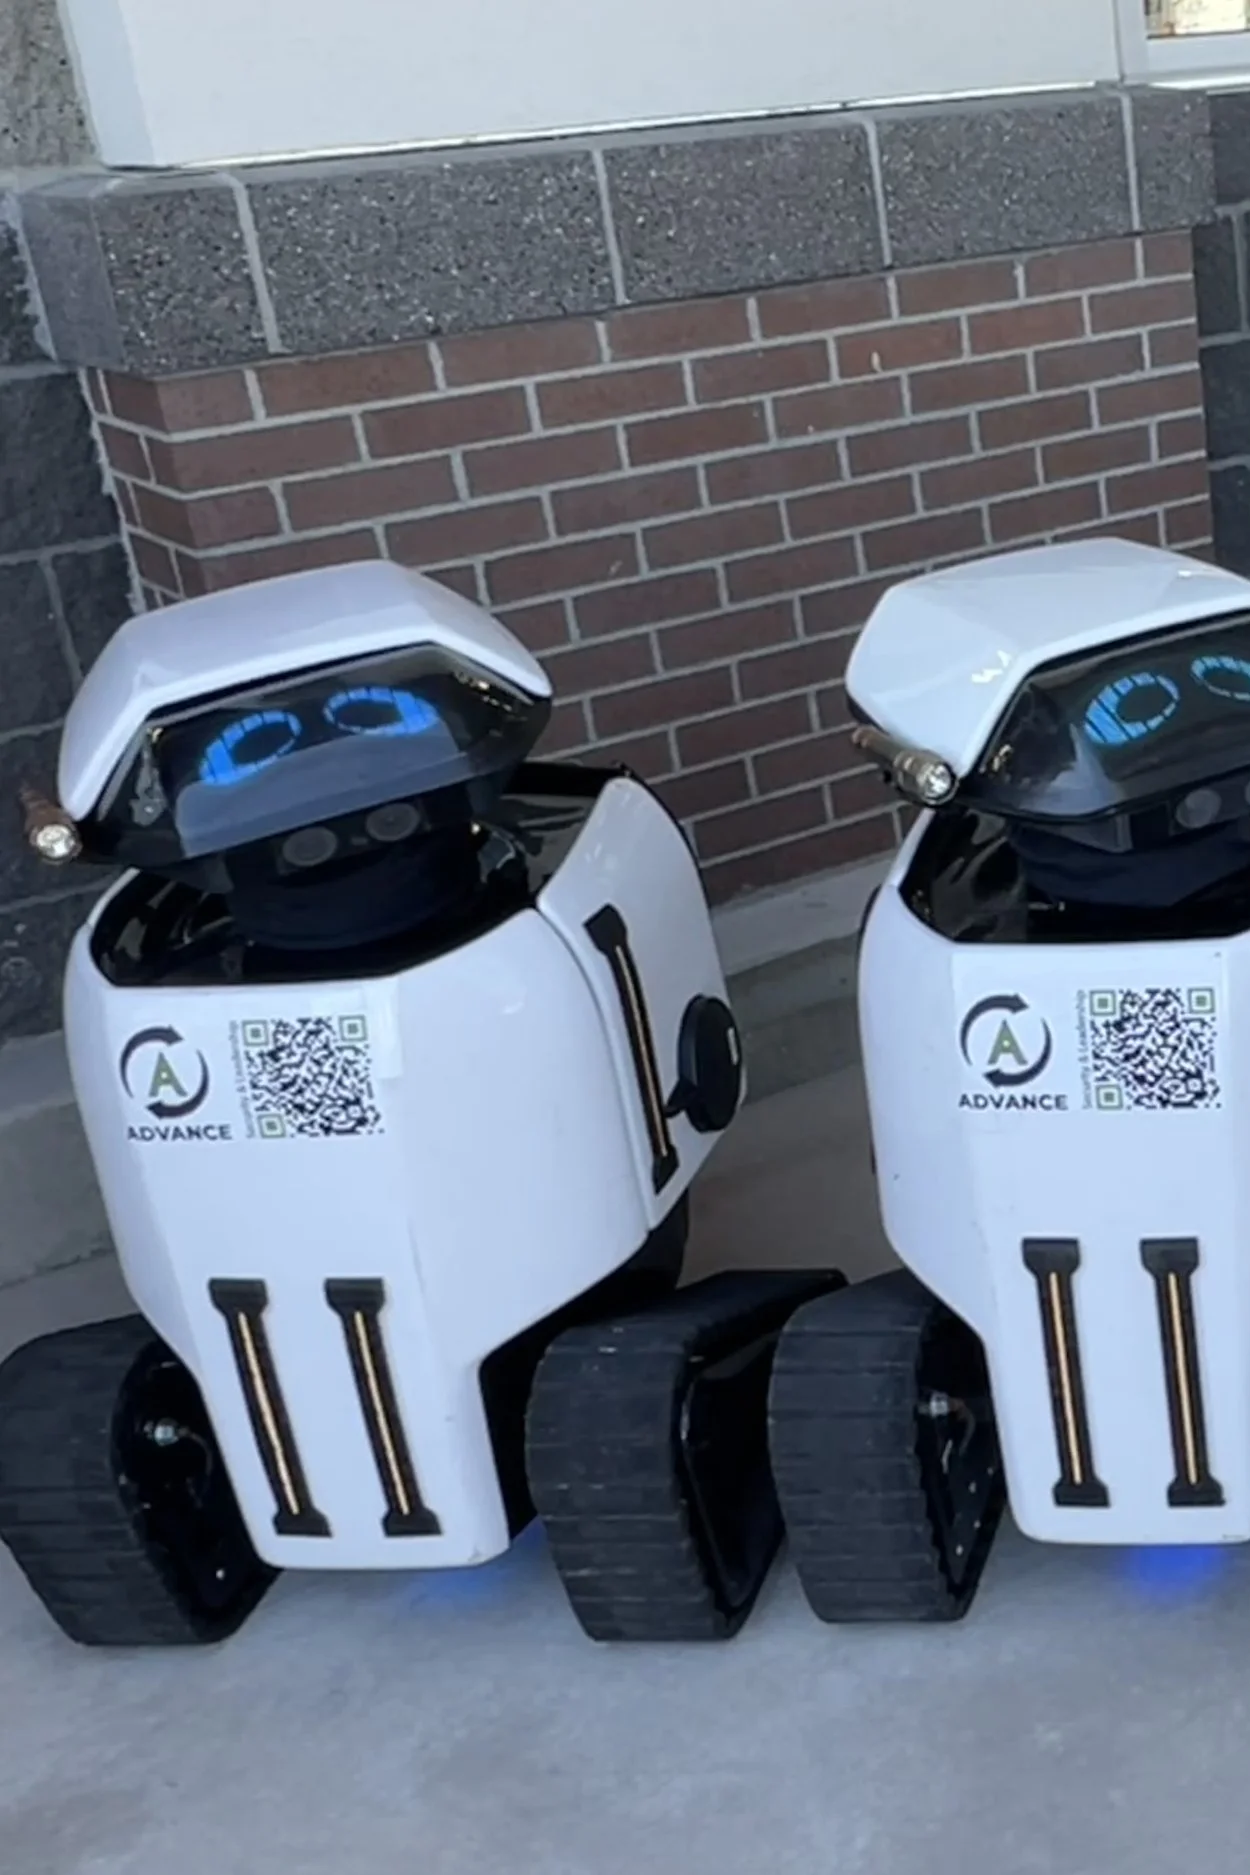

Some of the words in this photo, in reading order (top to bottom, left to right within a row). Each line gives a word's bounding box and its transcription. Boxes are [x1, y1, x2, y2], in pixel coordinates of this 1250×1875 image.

[986, 1018, 1029, 1066] A
[148, 1051, 189, 1098] A
[958, 1093, 1069, 1111] ADVANCE
[127, 1123, 233, 1142] ADVANCE
